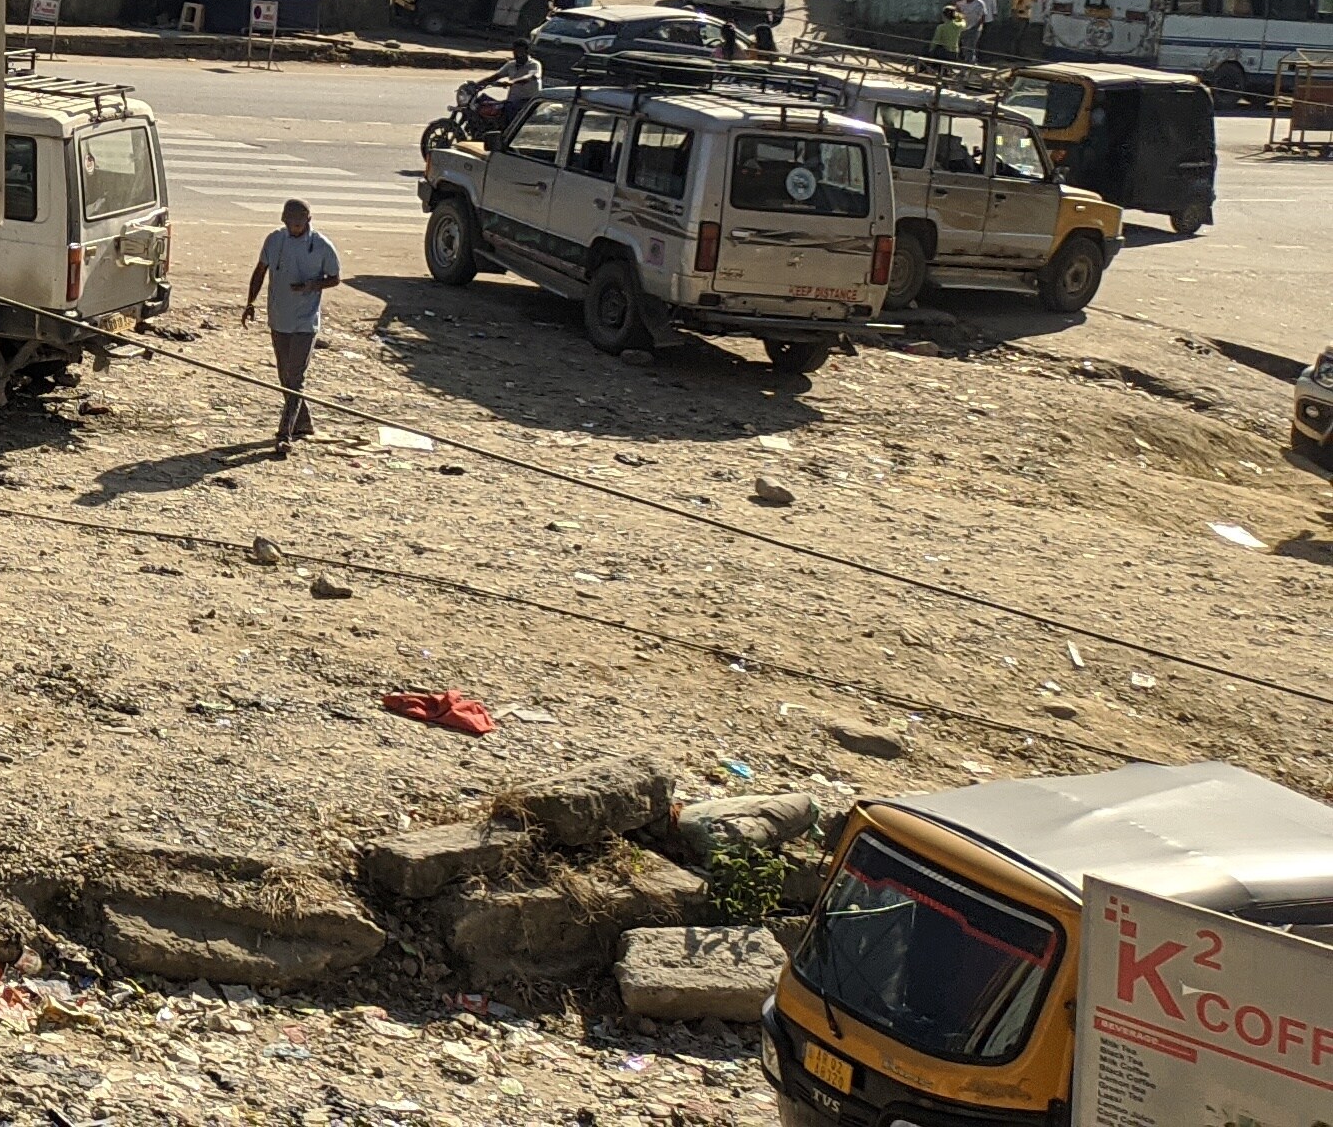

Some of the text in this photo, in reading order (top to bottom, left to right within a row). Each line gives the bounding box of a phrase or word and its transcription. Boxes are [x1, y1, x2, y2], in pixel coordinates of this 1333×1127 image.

[815, 287, 858, 300] DISTANCE
[1099, 1045, 1144, 1067] Black Tea
[1121, 1044, 1138, 1055] Tea
[1098, 1063, 1156, 1090] Black Coffee
[812, 1087, 841, 1115] TVS
[1128, 1091, 1144, 1103] Tea
